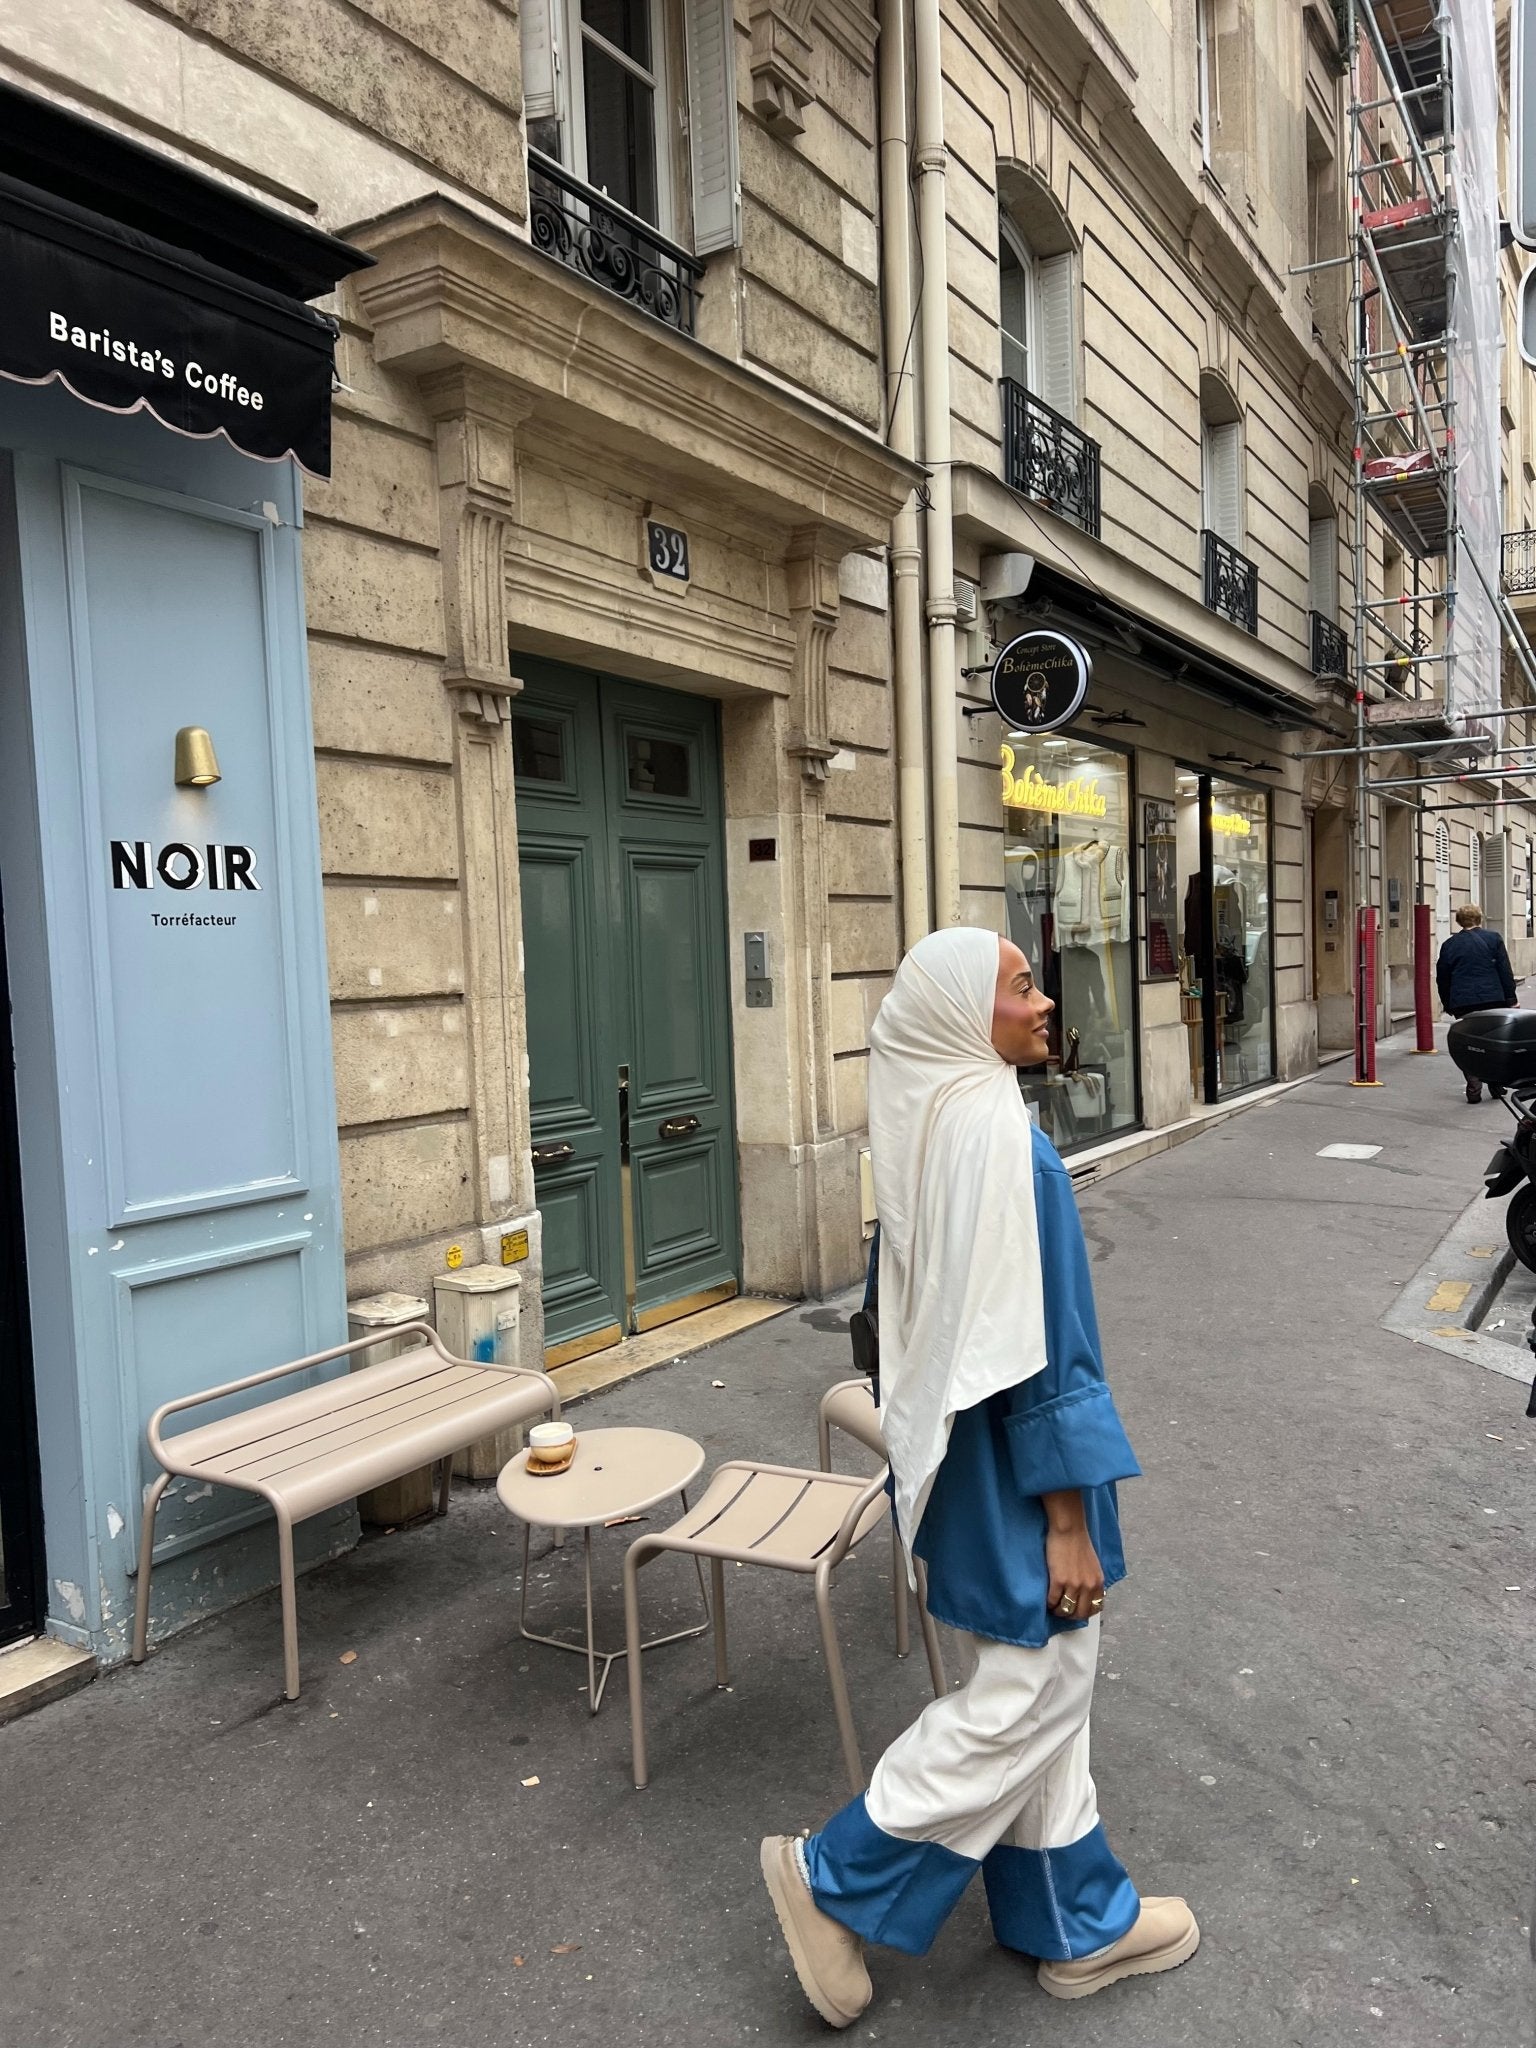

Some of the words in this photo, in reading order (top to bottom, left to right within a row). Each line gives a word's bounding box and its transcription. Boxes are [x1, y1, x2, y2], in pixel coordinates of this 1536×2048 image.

[50, 311, 175, 379] Barista’s
[185, 362, 264, 411] Coffee
[654, 527, 686, 576] 32
[110, 840, 263, 891] NOIR
[151, 913, 237, 927] Torréfacteur
